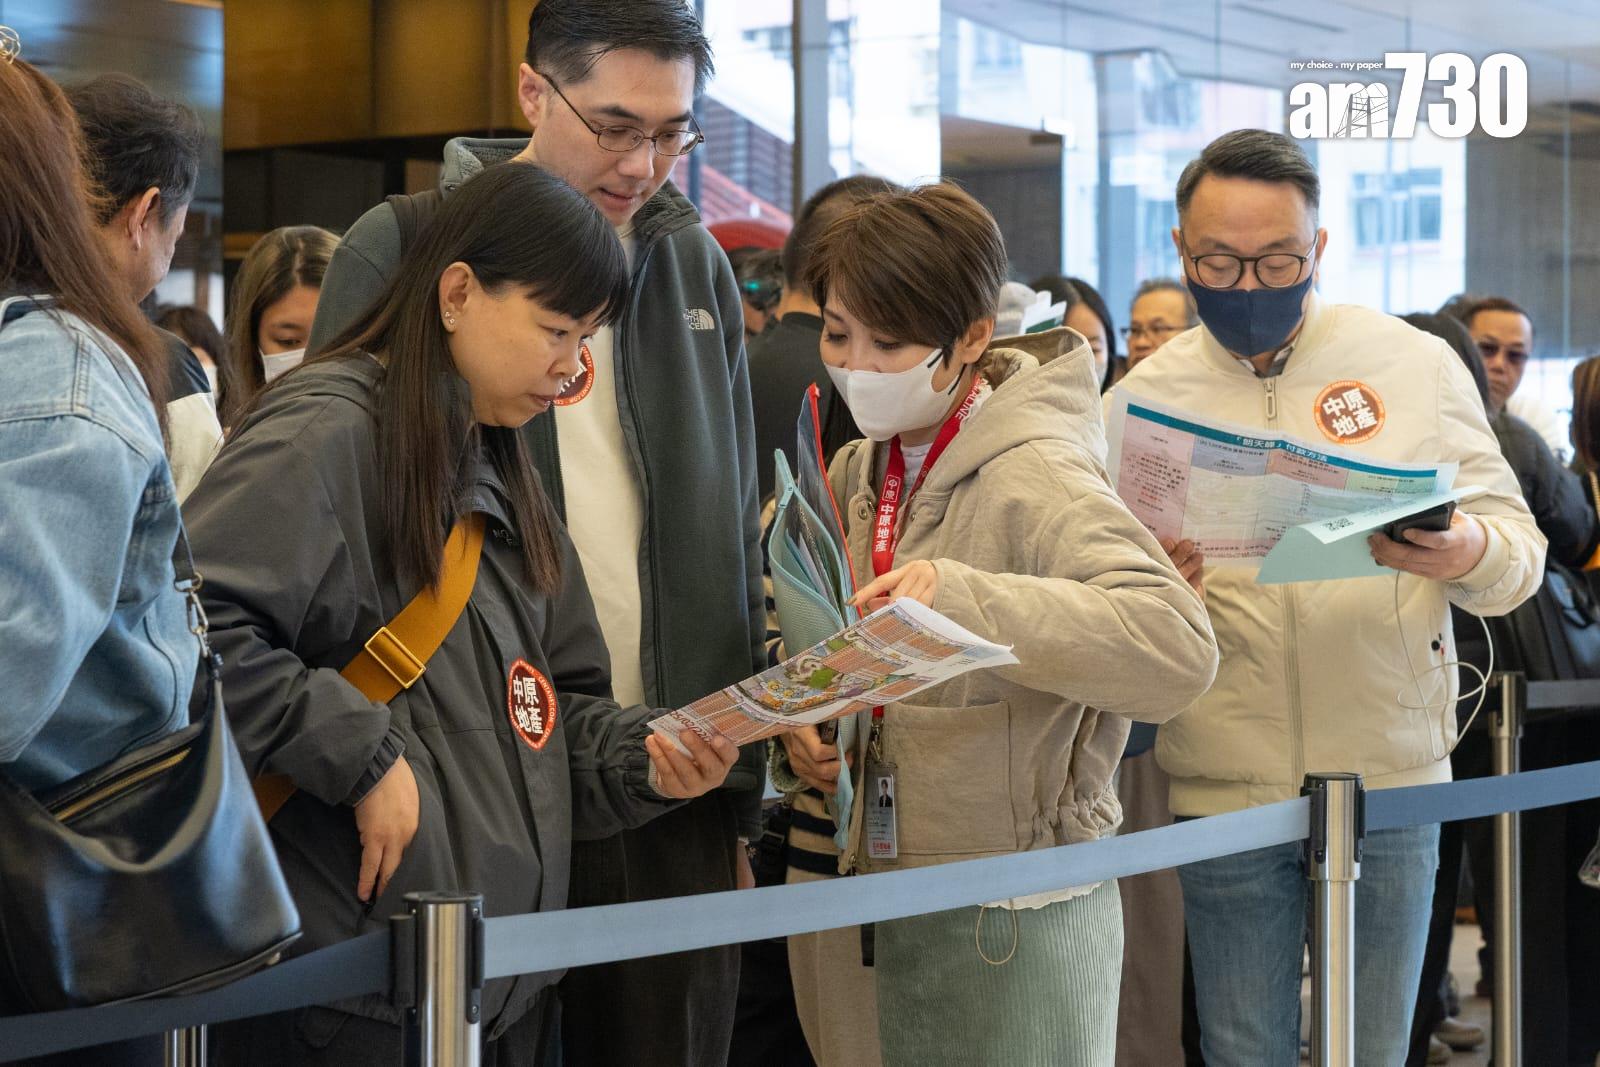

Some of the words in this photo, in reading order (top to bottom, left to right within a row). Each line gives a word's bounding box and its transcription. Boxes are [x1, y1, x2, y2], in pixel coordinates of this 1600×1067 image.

[1322, 387, 1368, 416] 中原
[1332, 406, 1378, 437] 地產
[875, 503, 895, 553] 中原地產
[512, 675, 539, 706] 中原
[515, 704, 544, 734] 地產
